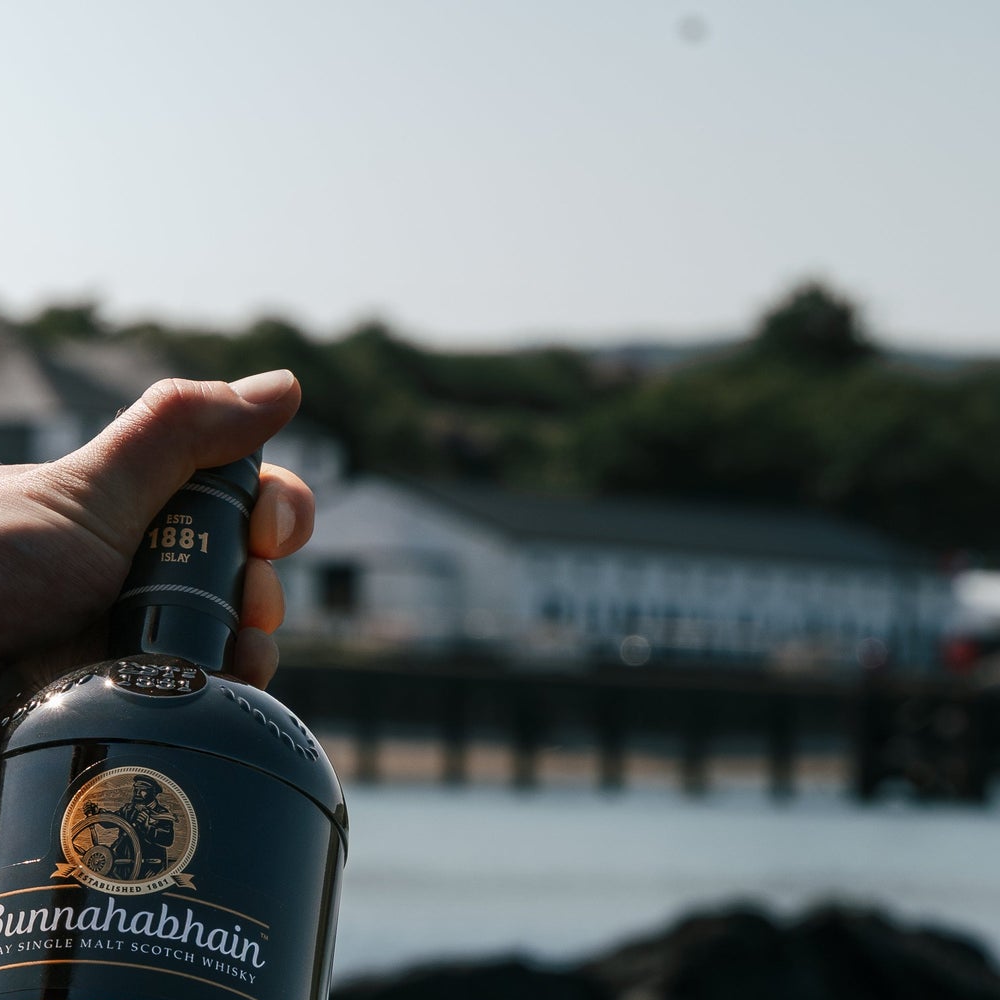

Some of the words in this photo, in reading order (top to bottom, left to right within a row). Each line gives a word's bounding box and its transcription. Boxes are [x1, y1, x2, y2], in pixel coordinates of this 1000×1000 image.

[166, 514, 193, 525] ESTD
[148, 527, 209, 554] 1881
[161, 552, 191, 563] ISLAY
[77, 872, 142, 893] ESTABLISHED
[147, 878, 169, 891] 1881
[17, 938, 73, 952] SINGLE
[80, 938, 125, 951] MALT
[131, 942, 195, 964] SCOTCH
[202, 955, 257, 984] WHISKY
